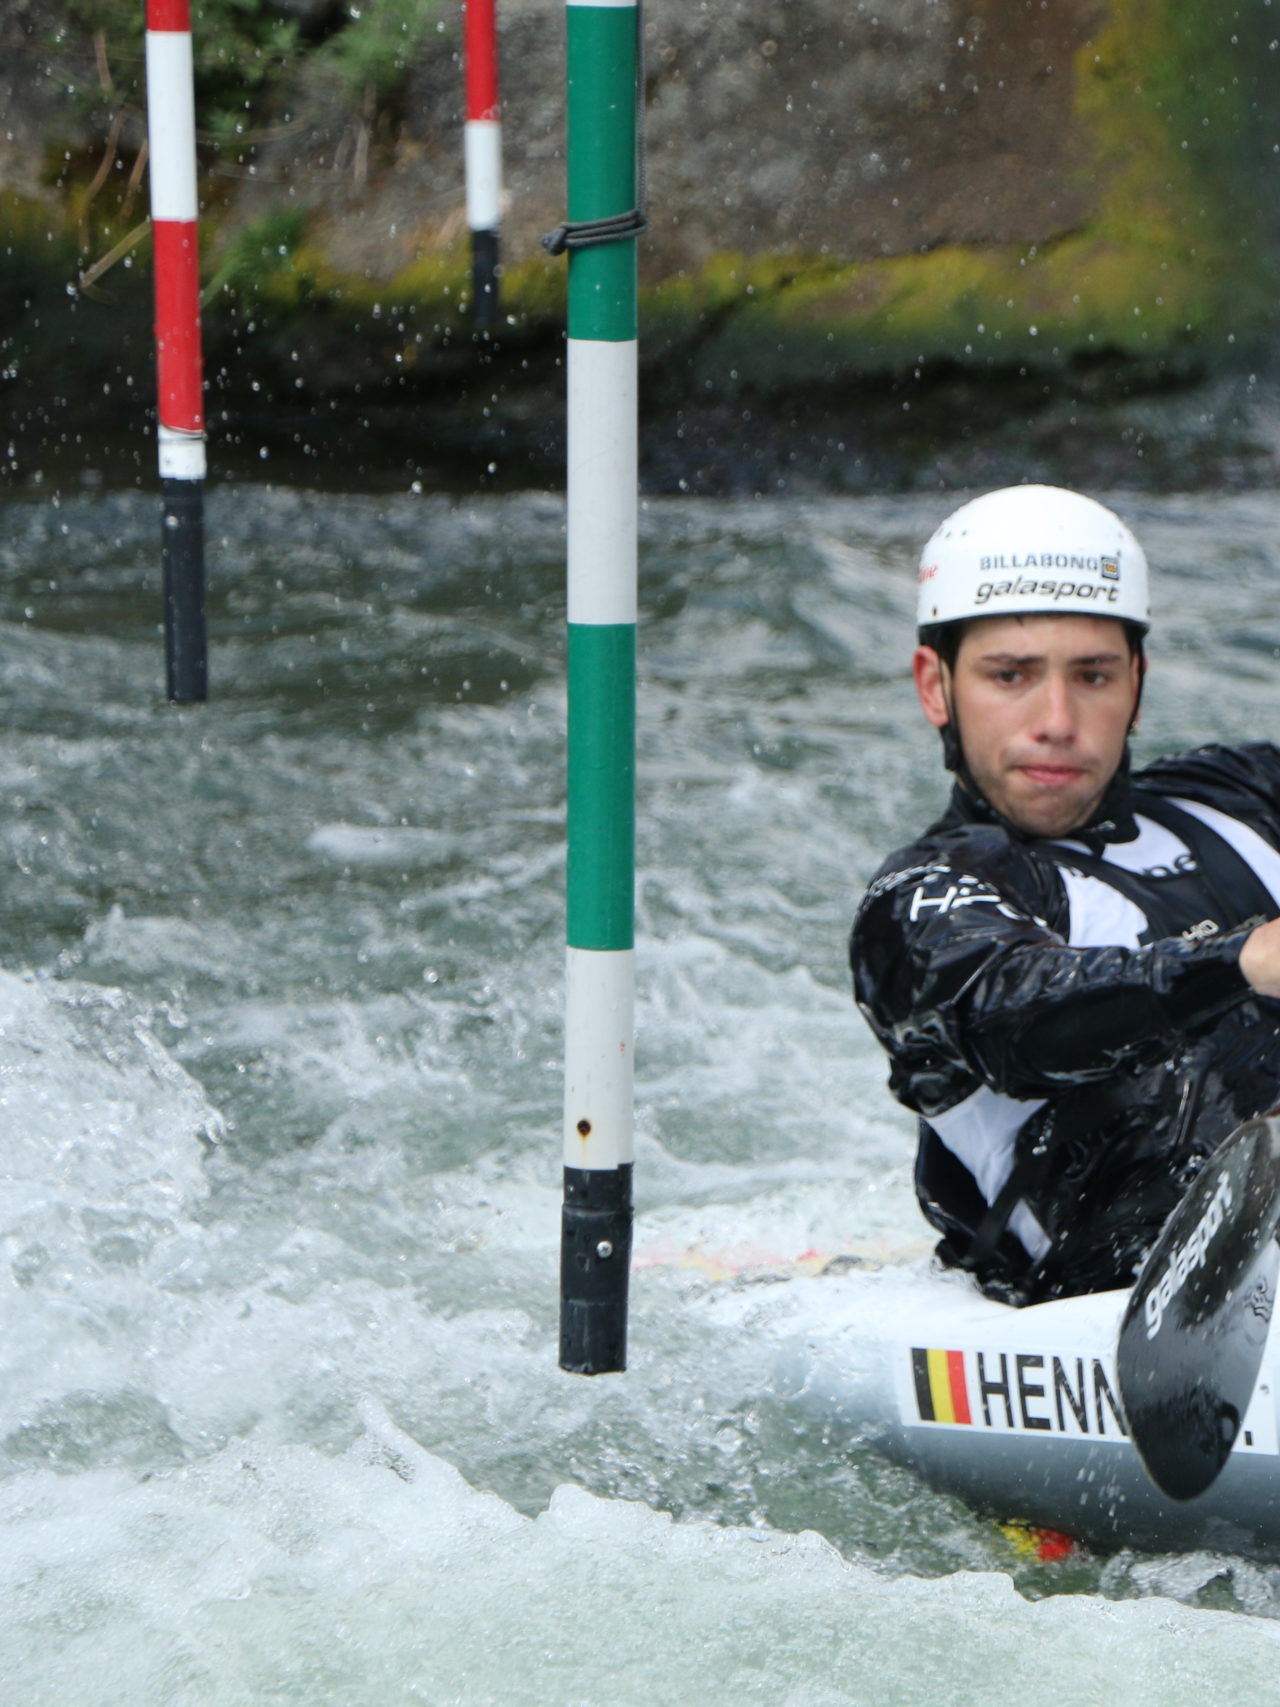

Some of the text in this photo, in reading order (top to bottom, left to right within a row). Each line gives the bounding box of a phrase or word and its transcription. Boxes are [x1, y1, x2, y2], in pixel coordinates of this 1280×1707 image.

[974, 574, 1120, 605] galasport
[979, 552, 1099, 572] BILLABONG
[1145, 1169, 1233, 1340] galasport
[975, 1351, 1131, 1437] HENN
